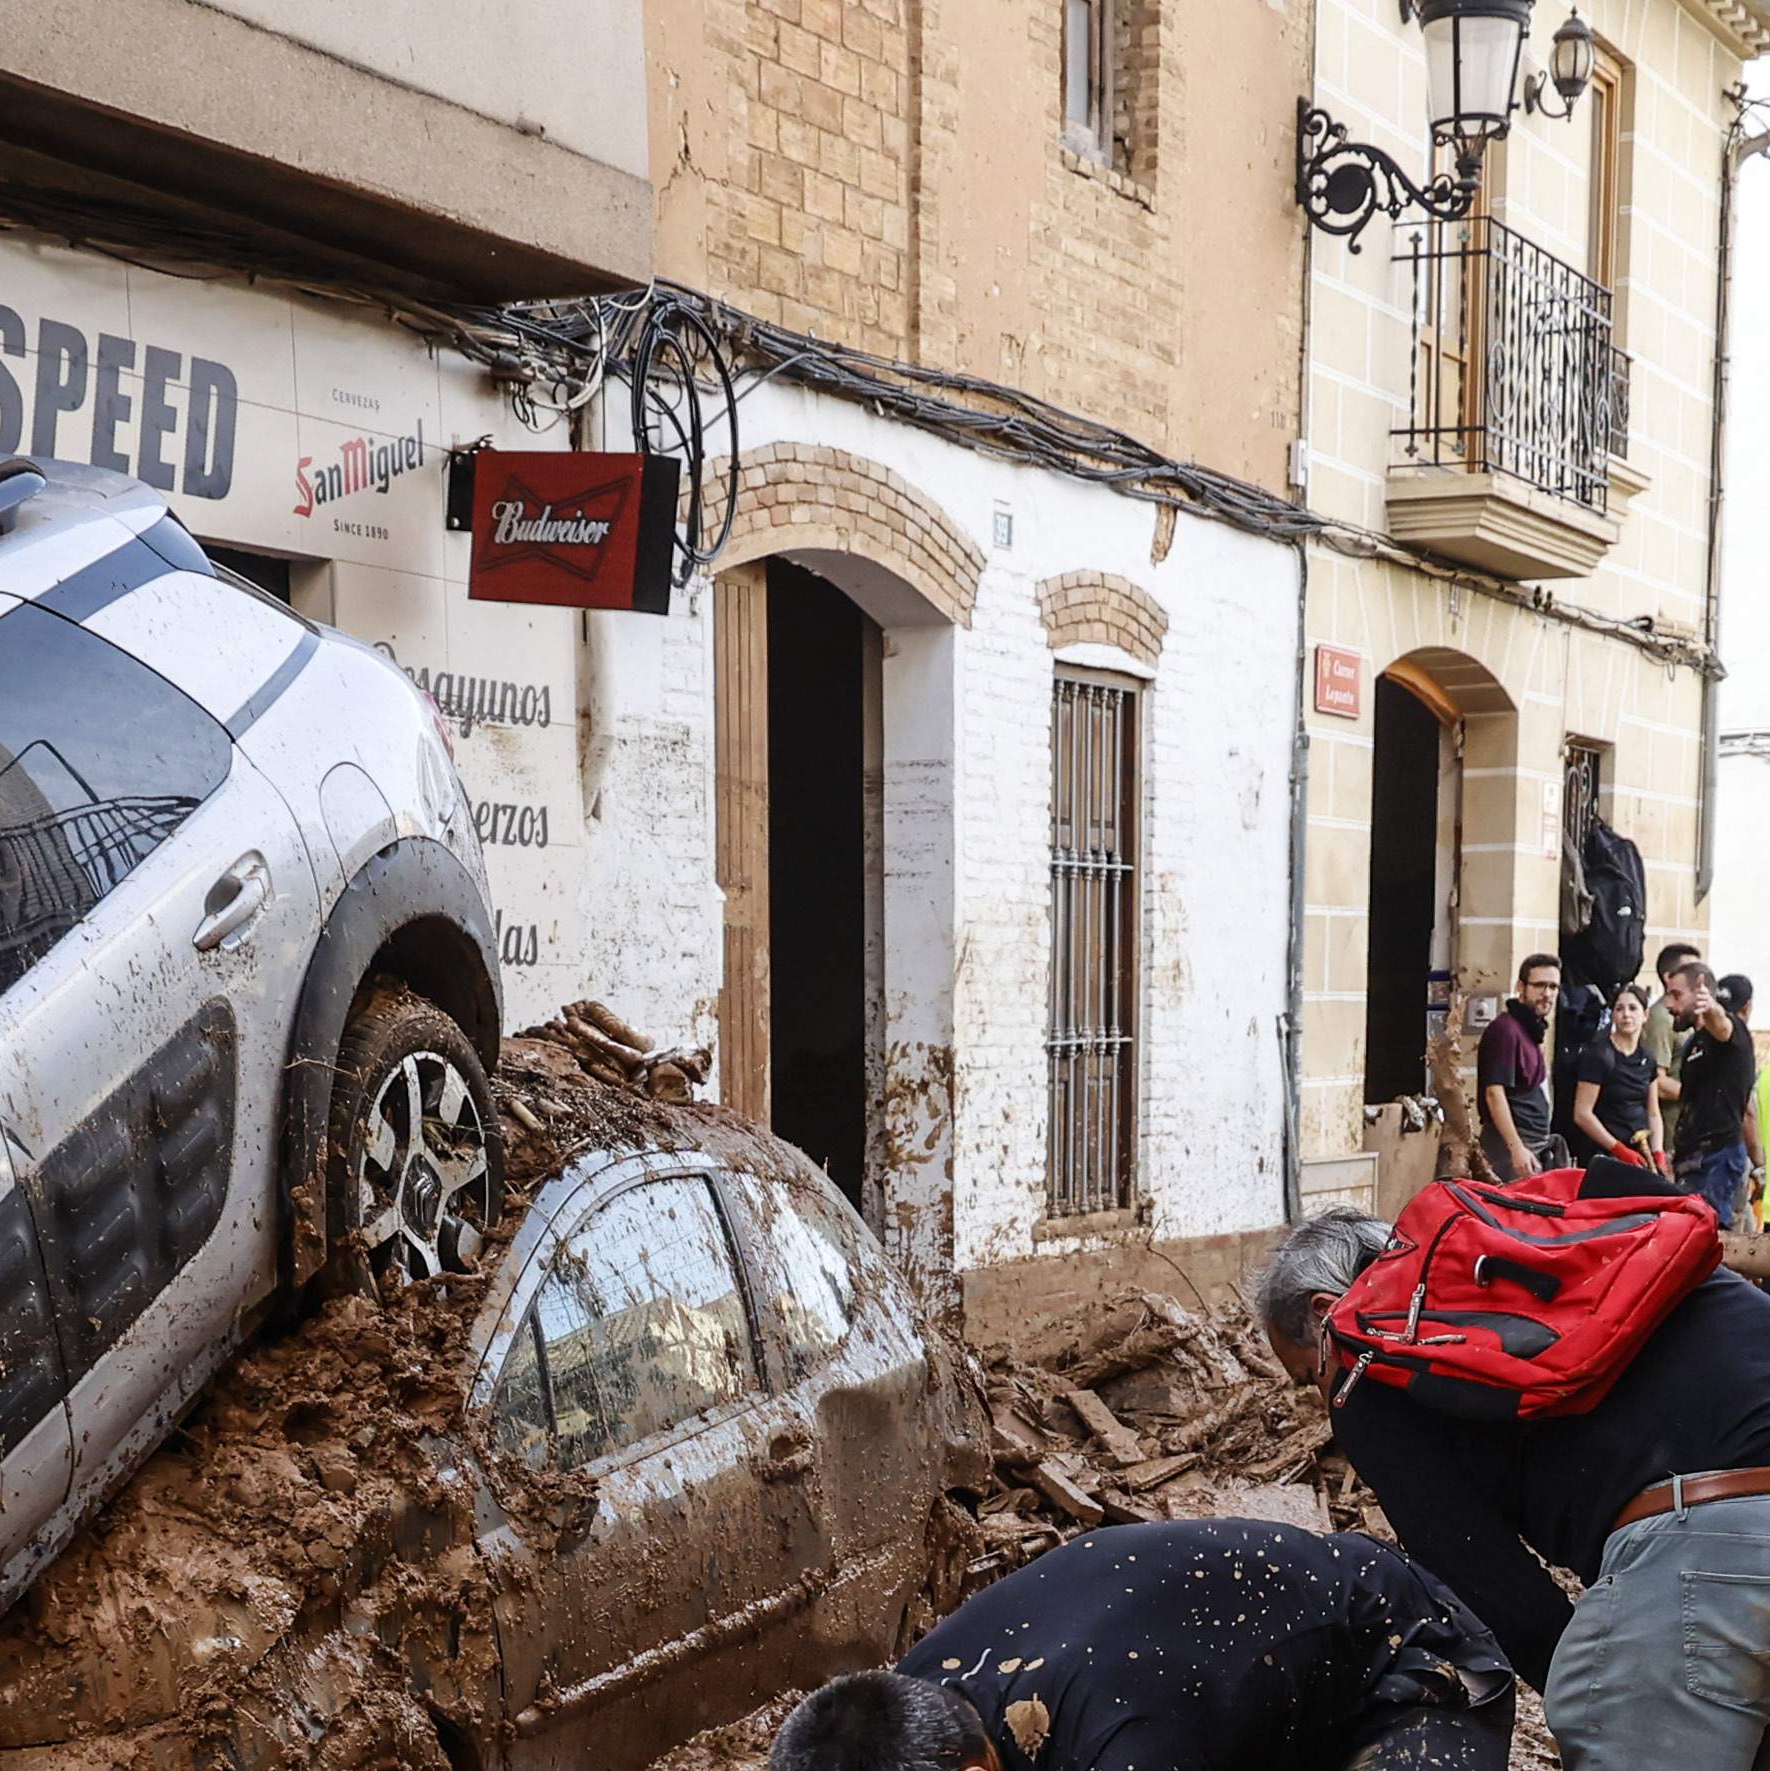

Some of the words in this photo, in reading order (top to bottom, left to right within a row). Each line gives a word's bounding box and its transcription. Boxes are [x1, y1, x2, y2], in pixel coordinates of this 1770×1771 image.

[333, 518, 362, 536] SINCE
[365, 525, 389, 541] 1890
[492, 501, 610, 544] Budweiser
